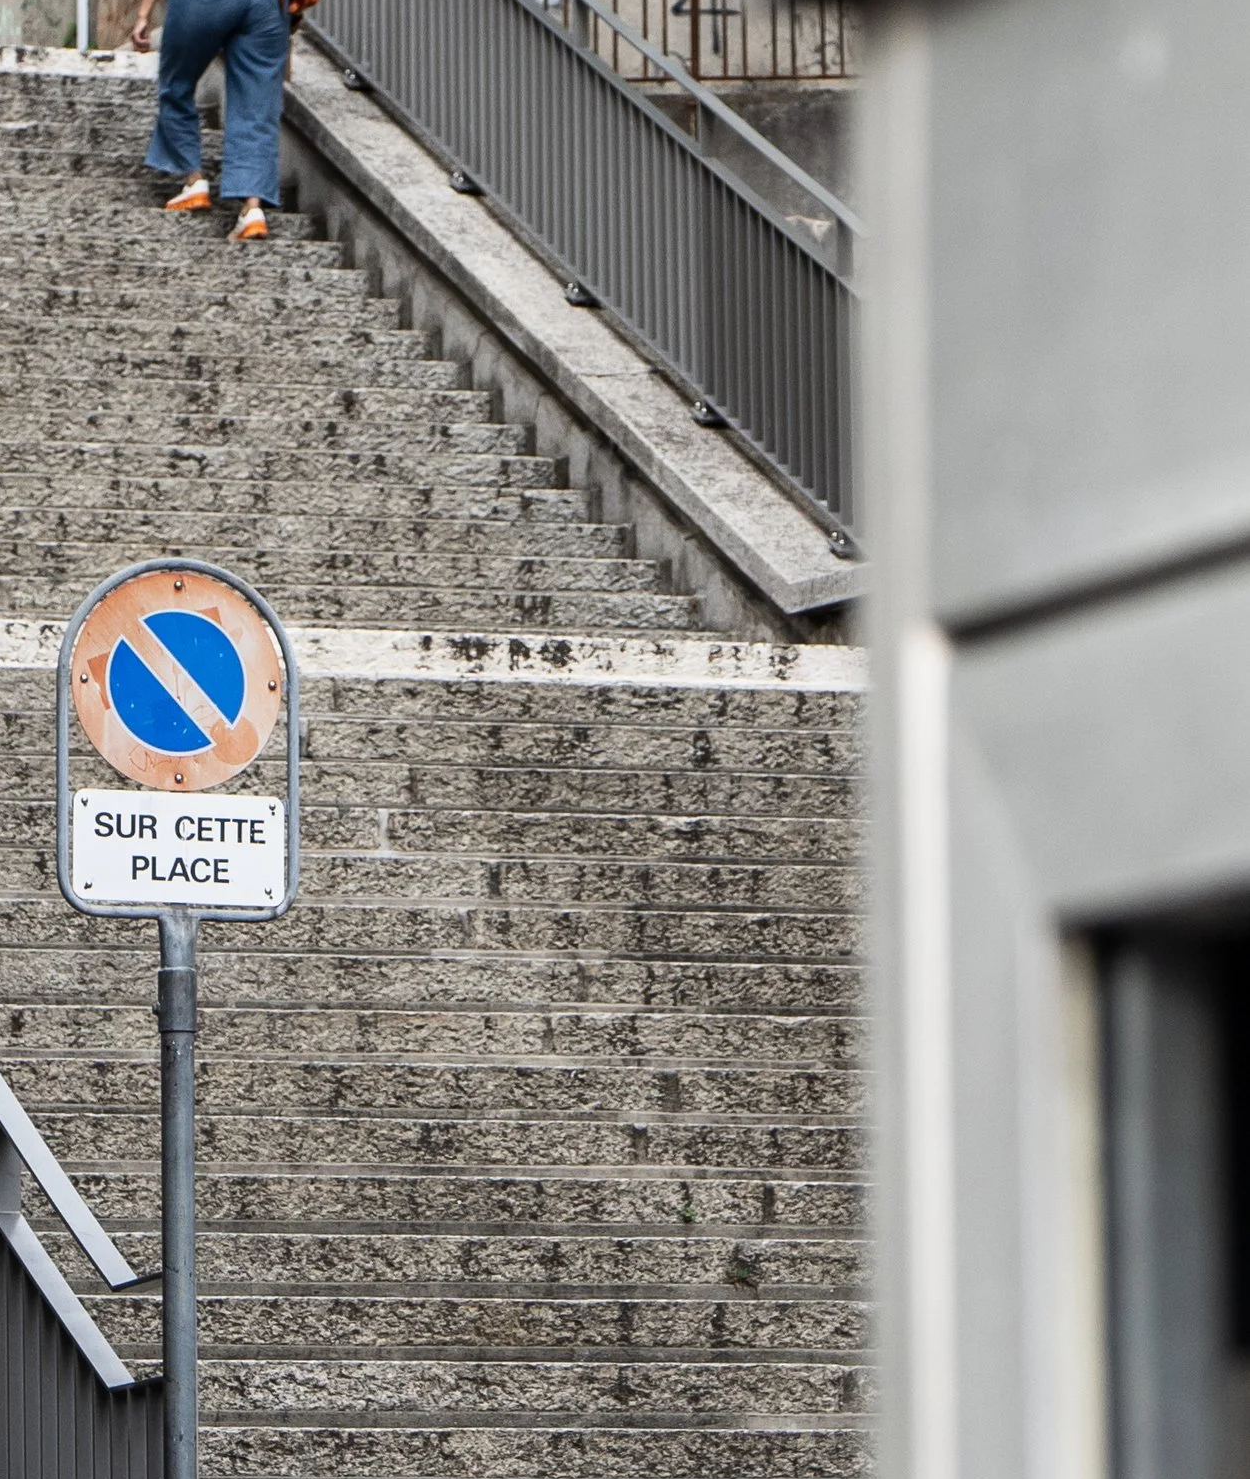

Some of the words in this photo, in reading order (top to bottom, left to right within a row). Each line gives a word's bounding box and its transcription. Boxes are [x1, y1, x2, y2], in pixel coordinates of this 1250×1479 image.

[93, 811, 158, 840] SUR
[174, 815, 267, 845] CETTE
[131, 854, 231, 884] PLACE
